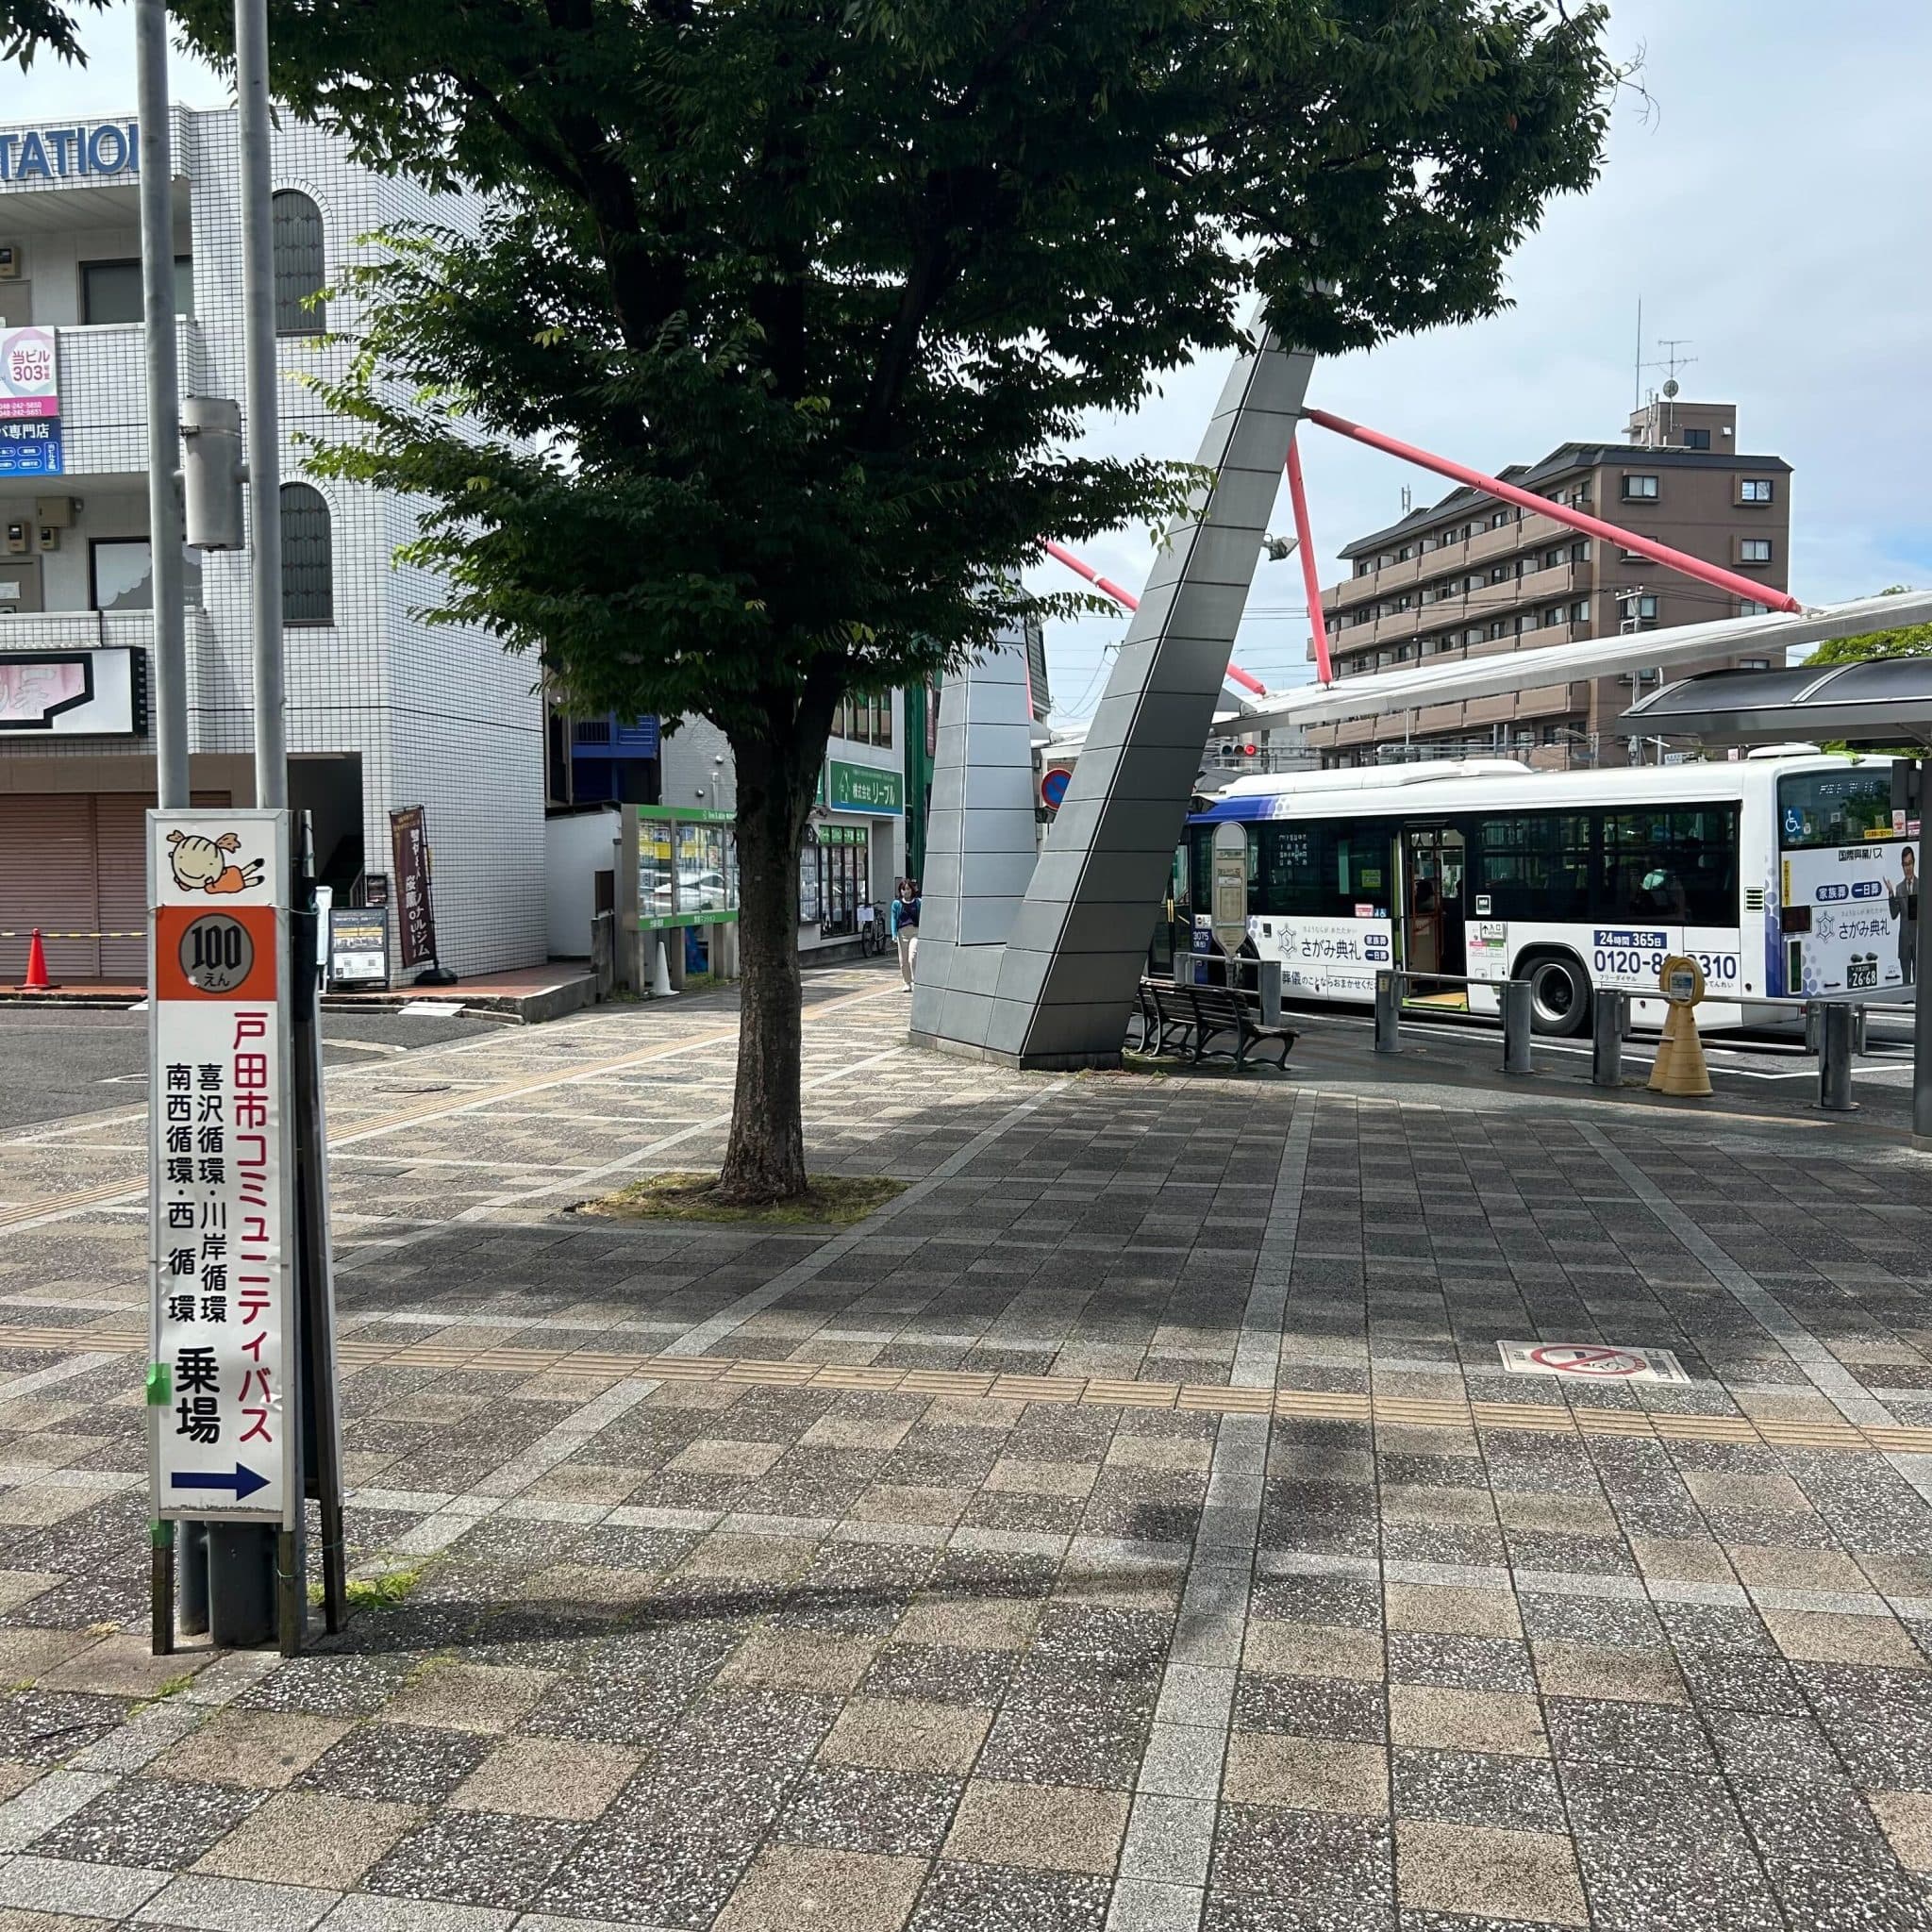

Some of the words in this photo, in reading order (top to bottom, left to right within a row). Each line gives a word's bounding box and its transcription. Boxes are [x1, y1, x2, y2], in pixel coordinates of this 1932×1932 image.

[12, 350, 50, 364] 当ビル
[1819, 886, 1847, 899] 家族葬
[1854, 884, 1880, 896] 一日葬
[1192, 930, 1209, 941] 3075
[1840, 918, 1890, 939] さがみ典礼
[1599, 932, 1629, 946] 24時間
[1632, 933, 1661, 947] 365日
[192, 924, 242, 970] 100
[1301, 938, 1361, 960] さがみ典礼
[204, 973, 230, 987] えん
[175, 1346, 221, 1444] 乗場
